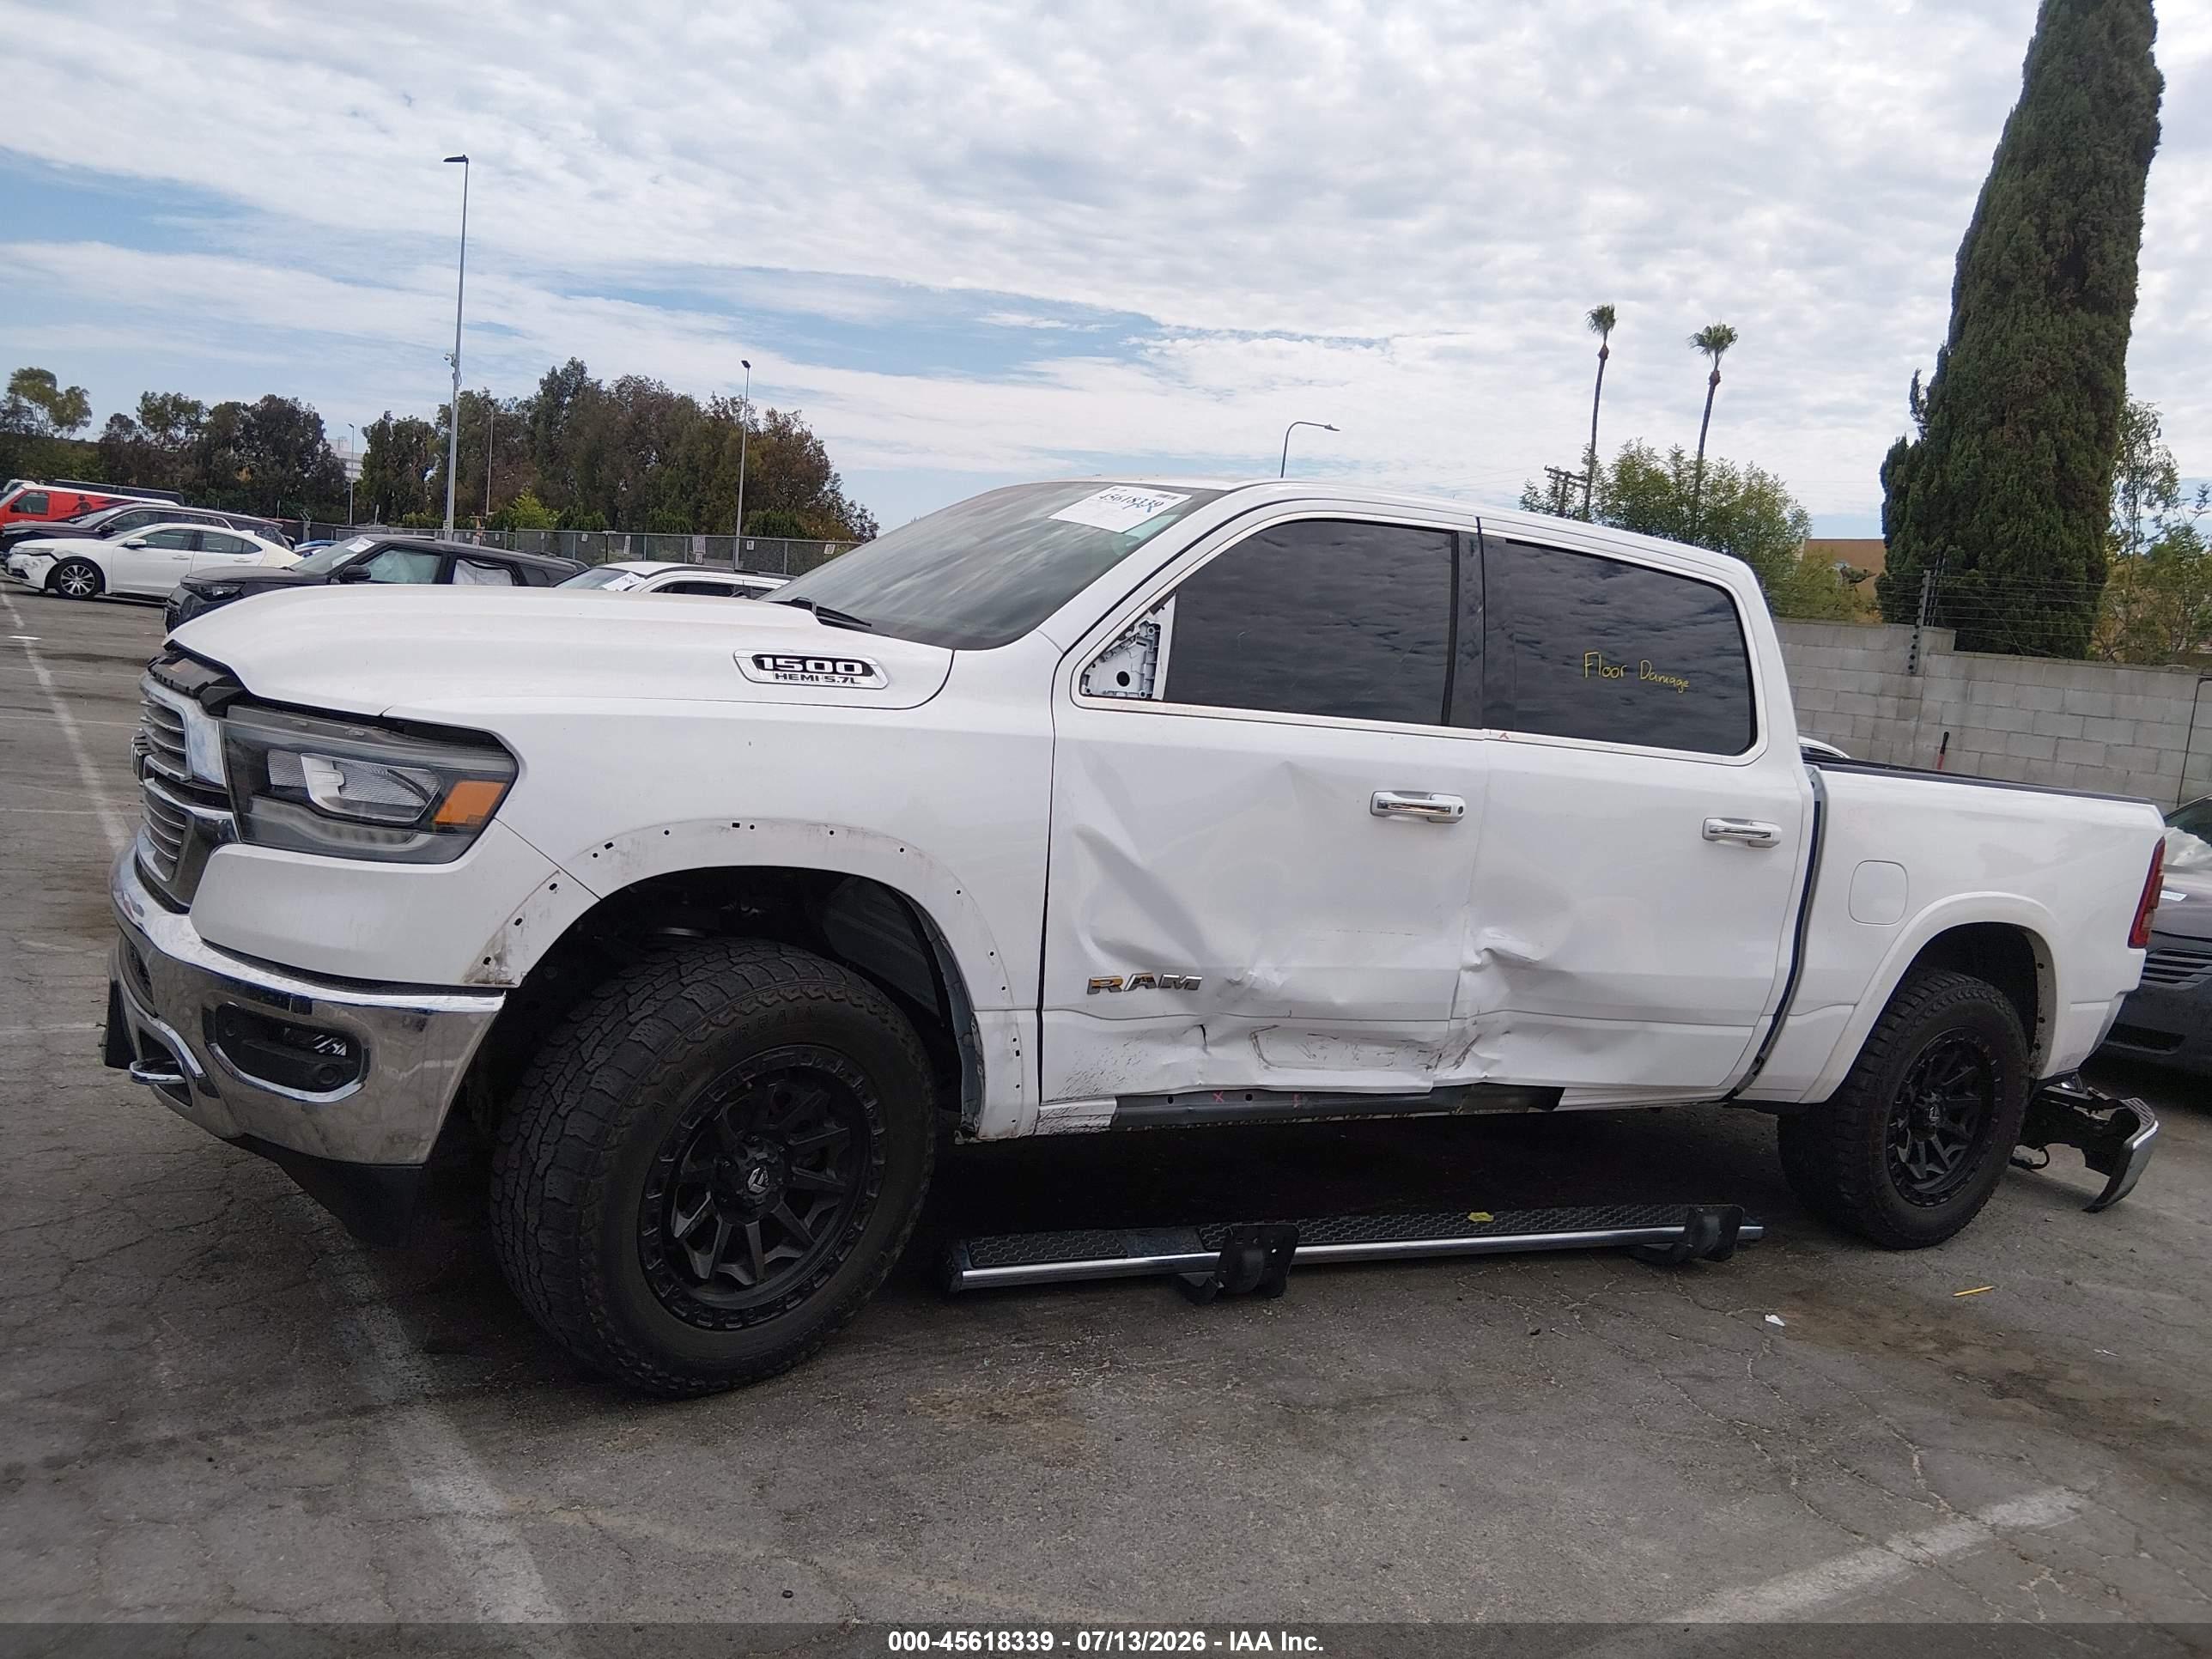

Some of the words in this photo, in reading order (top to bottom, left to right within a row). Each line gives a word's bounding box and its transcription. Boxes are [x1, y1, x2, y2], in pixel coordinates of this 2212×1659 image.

[757, 656, 863, 674] 1500
[1584, 652, 1628, 678] Floor
[1640, 659, 1690, 693] Damage
[775, 672, 819, 682] HEMI
[824, 676, 860, 684] 5.7L
[1086, 973, 1203, 995] RAM
